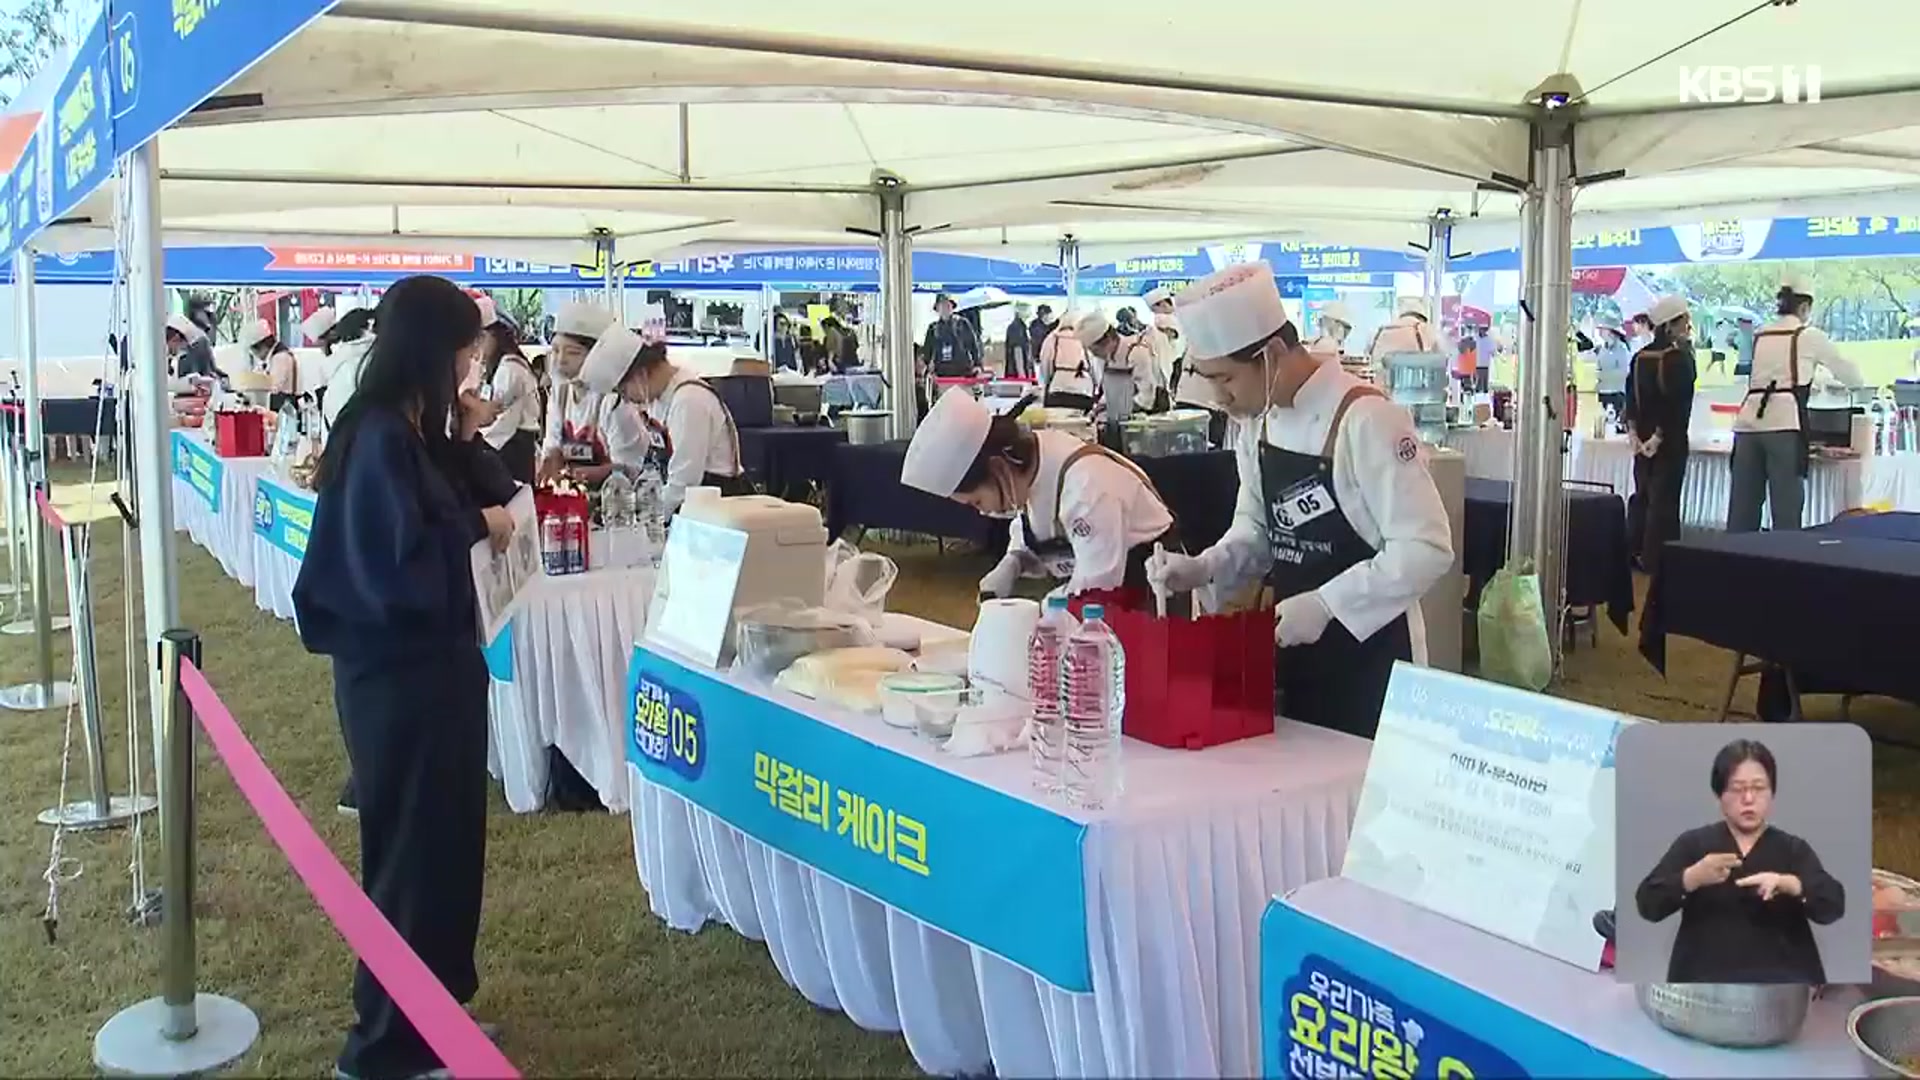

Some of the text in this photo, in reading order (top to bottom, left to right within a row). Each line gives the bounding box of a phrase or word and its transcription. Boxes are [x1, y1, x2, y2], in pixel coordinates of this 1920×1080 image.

[1296, 493, 1321, 515] 05
[671, 706, 698, 766] 05
[754, 751, 931, 877] 막걸리 케이크
[1288, 991, 1420, 1080] 요리왕
